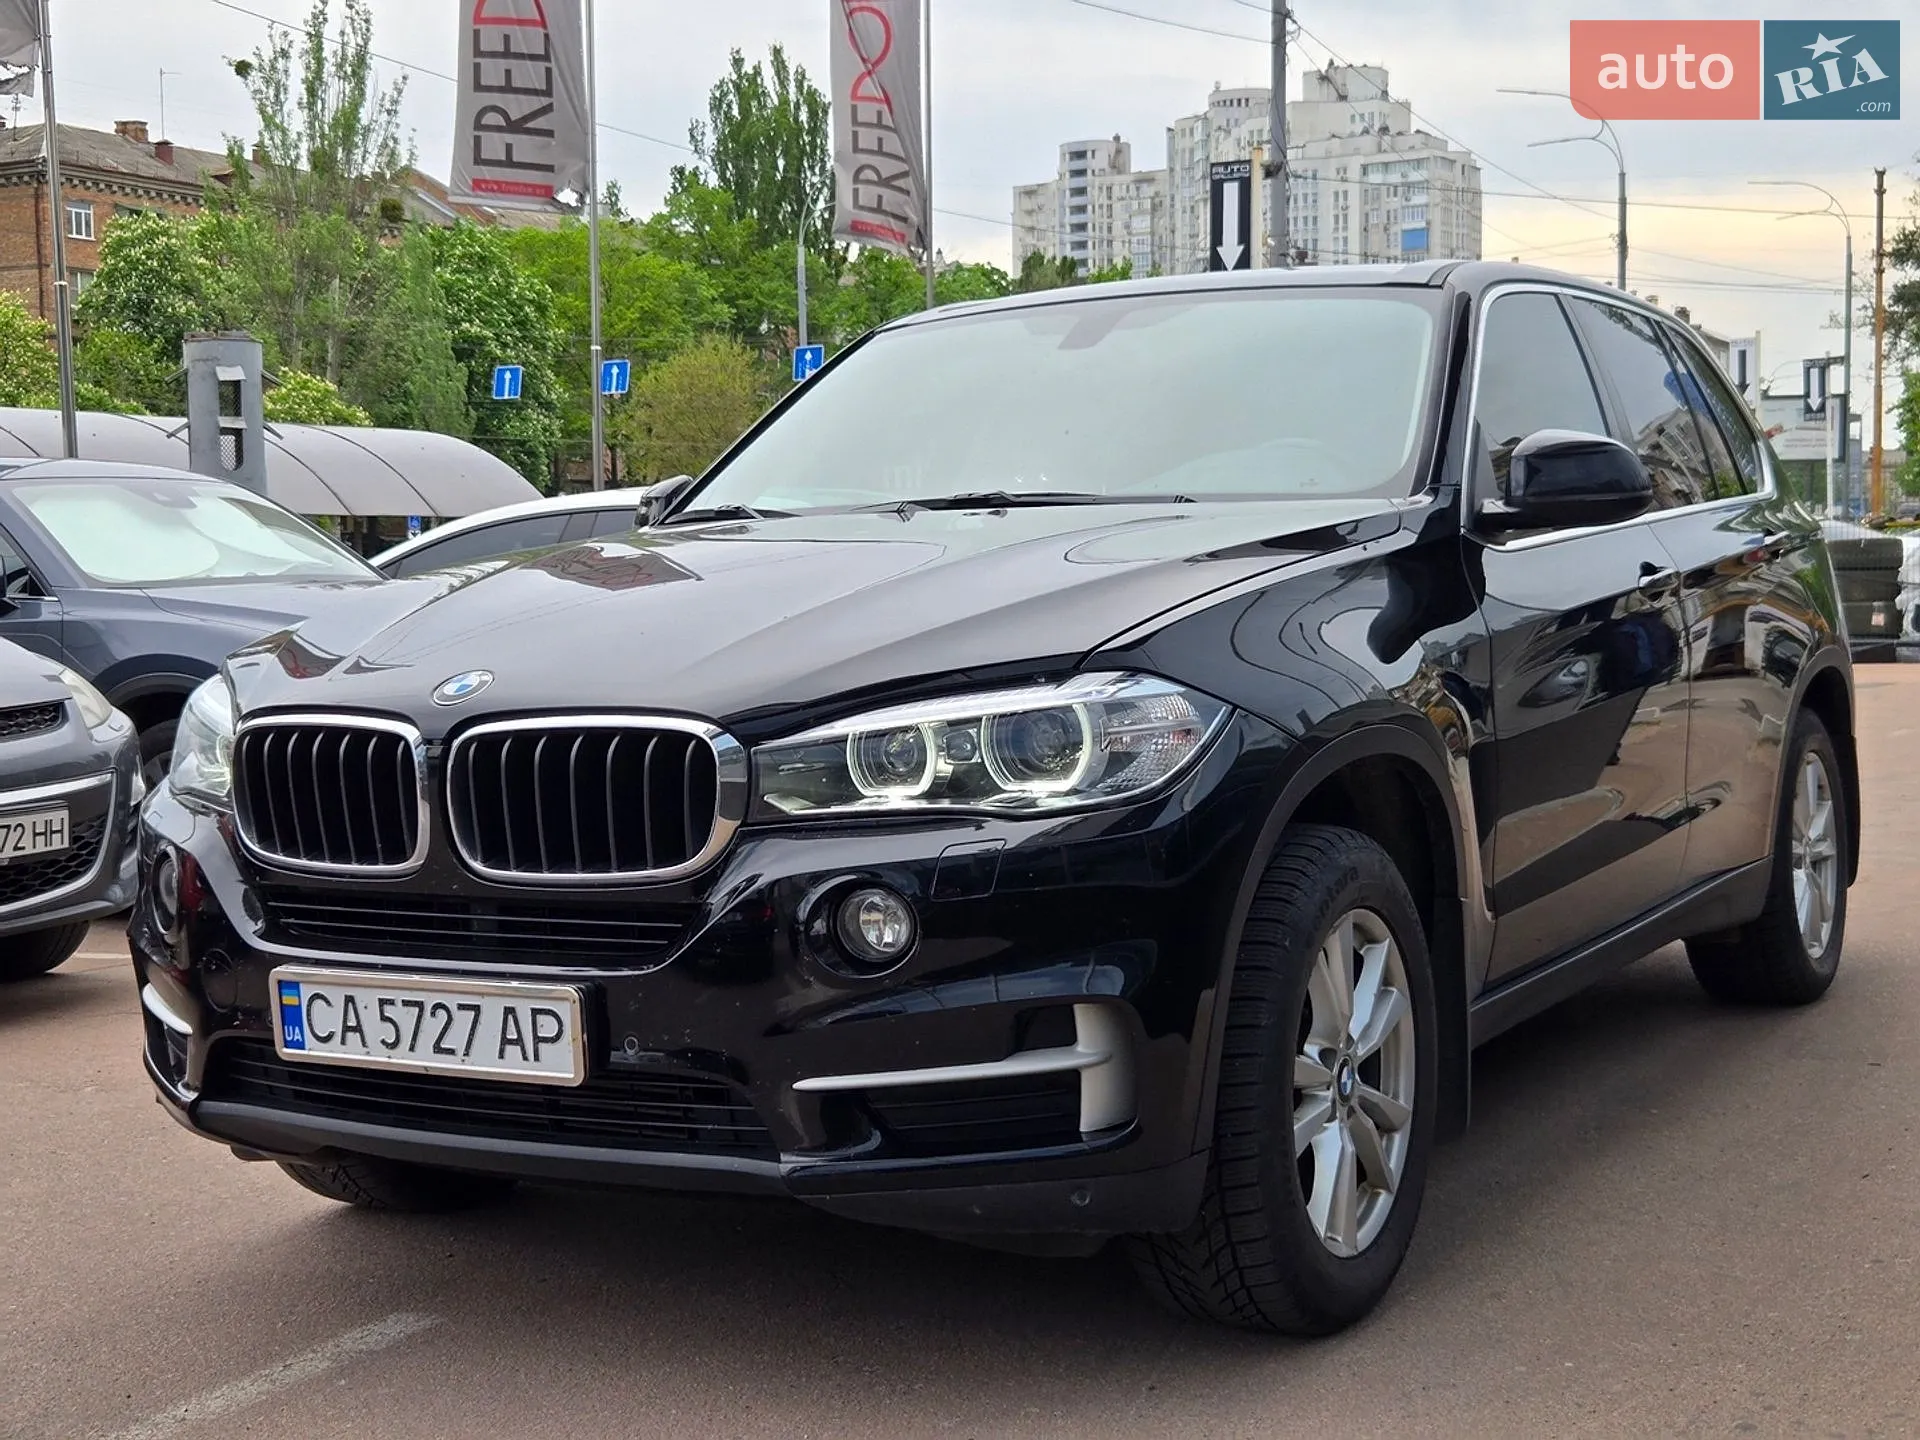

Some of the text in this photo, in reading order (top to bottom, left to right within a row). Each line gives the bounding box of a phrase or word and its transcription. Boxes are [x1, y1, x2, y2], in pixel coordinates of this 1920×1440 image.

[848, 0, 911, 224] FREEDO
[0, 817, 64, 852] 72 HH
[284, 1024, 303, 1043] UA
[306, 992, 565, 1063] CA 5727 AP
